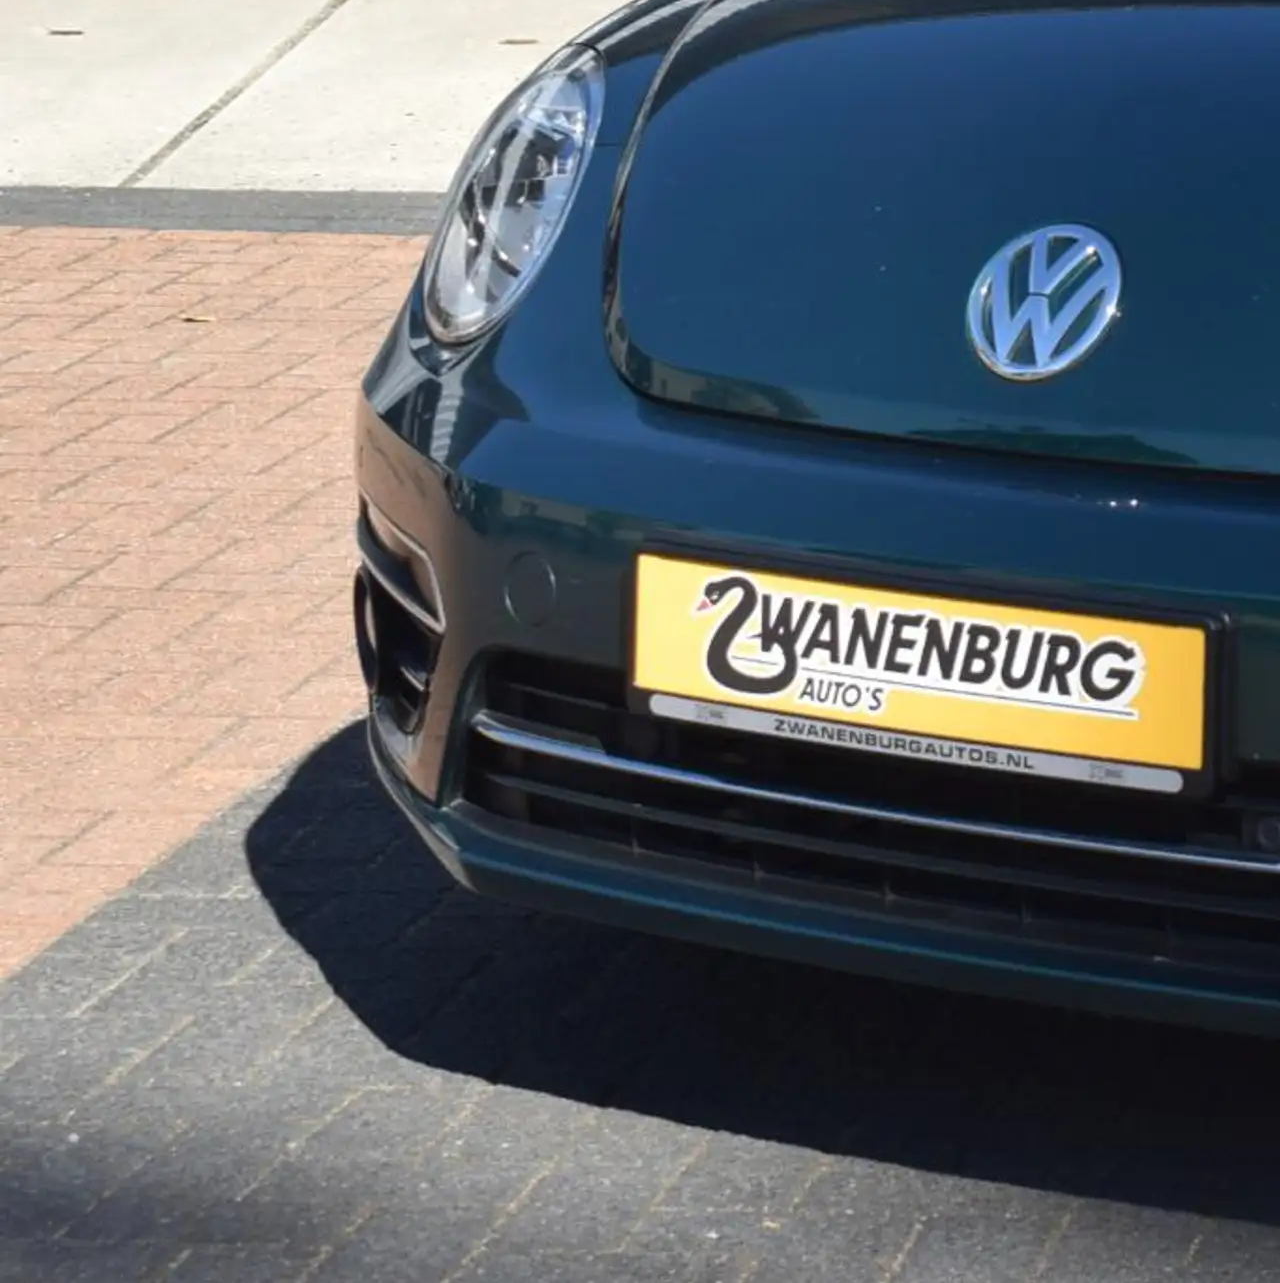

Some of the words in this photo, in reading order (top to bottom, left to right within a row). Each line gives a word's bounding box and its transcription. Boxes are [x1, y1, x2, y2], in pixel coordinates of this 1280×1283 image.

[970, 226, 1118, 378] VW
[799, 676, 885, 711] AUTO'S
[774, 718, 1035, 770] ZWANENBURGAUTOS.NL
